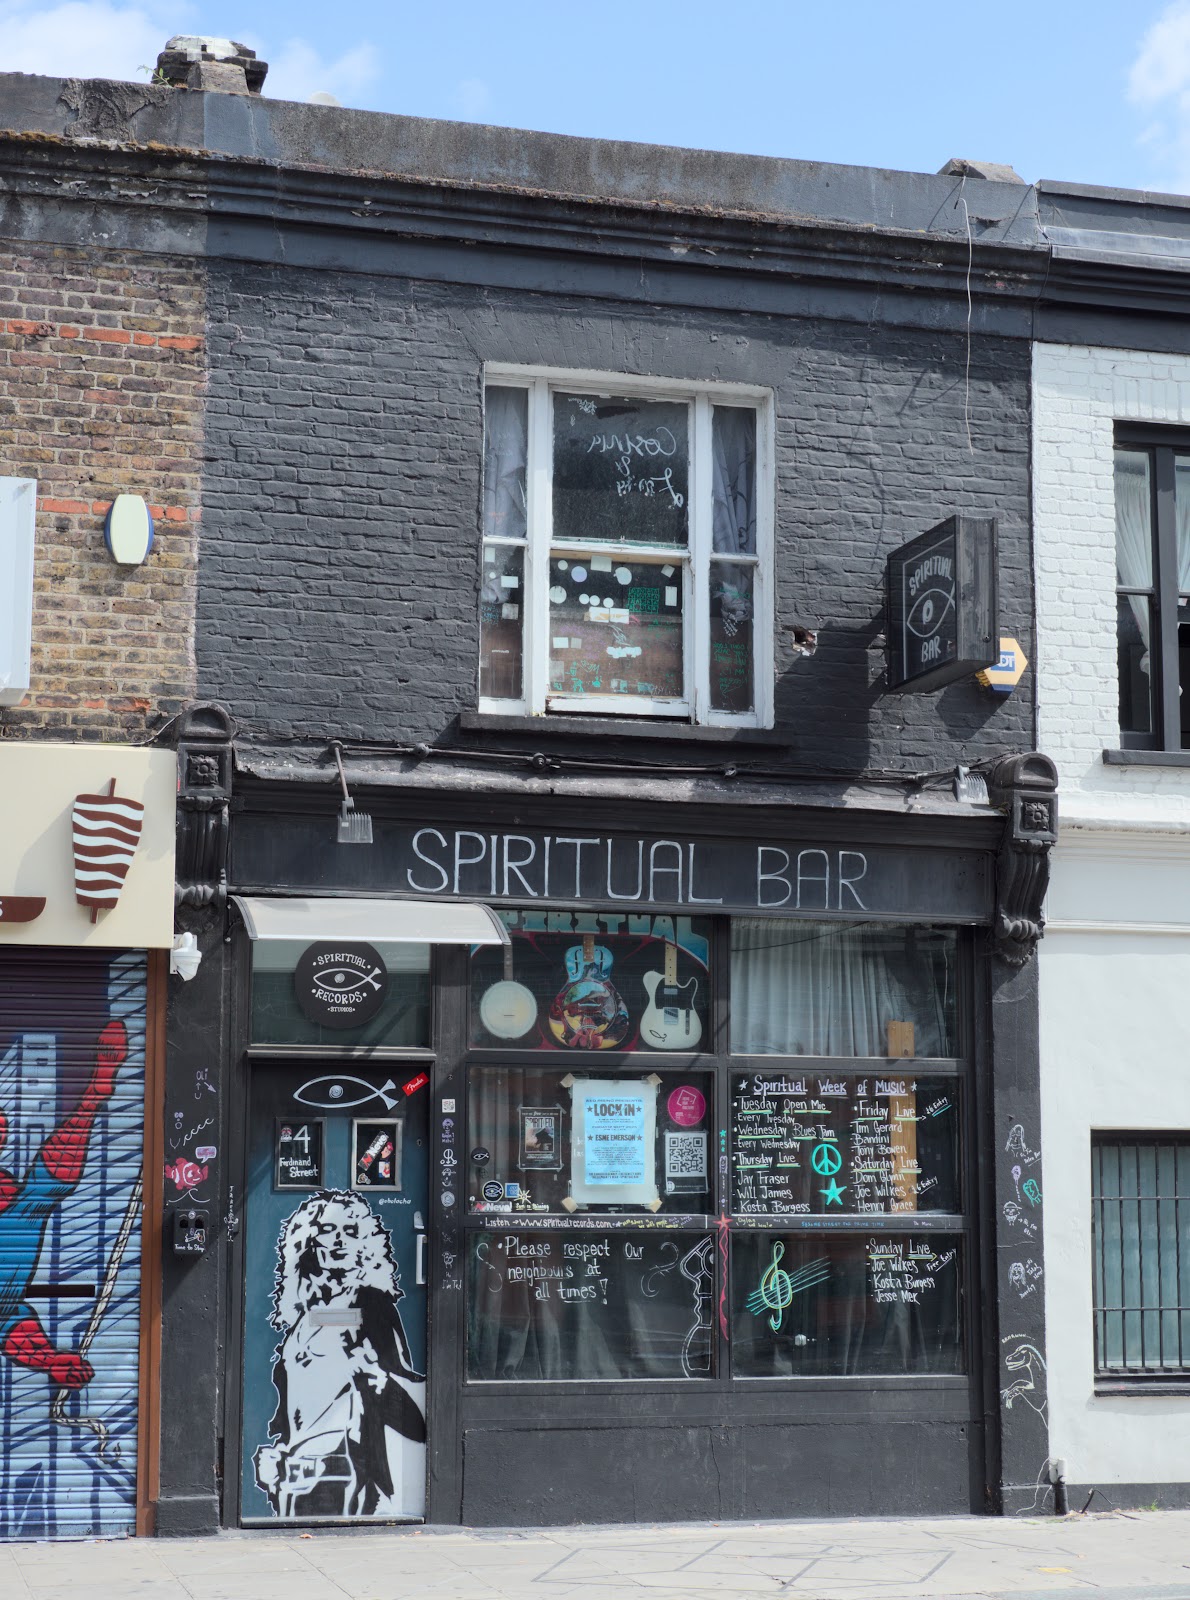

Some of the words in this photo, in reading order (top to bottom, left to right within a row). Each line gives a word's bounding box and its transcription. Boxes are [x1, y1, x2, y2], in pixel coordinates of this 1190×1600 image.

[909, 555, 953, 596] SPIRITUAL
[921, 636, 941, 662] BAR
[996, 656, 1015, 668] DT
[407, 828, 723, 904] SPIRITUAL
[757, 846, 868, 911] BAR
[317, 953, 366, 969] SPIRITUAL
[315, 989, 363, 1004] RECORDS
[753, 1075, 808, 1096] Spiritual
[818, 1079, 847, 1093] Week
[857, 1079, 868, 1093] of
[875, 1080, 906, 1093] MUSIC
[594, 1103, 623, 1117] LOCK
[736, 1096, 777, 1115] Tuesday
[783, 1099, 808, 1115] Open
[810, 1099, 826, 1110] Mic
[859, 1100, 889, 1120] Friday
[896, 1101, 916, 1118] Live
[933, 1096, 949, 1110] Entry
[737, 1112, 761, 1125] Every
[766, 1113, 796, 1126] Tuesday
[738, 1123, 787, 1137] Wednesday
[792, 1123, 817, 1137] Blues
[816, 1124, 836, 1139] Jam
[851, 1121, 870, 1133] Tim
[873, 1120, 903, 1135] Gerard
[293, 1125, 311, 1154] 4
[738, 1140, 757, 1151] Every
[760, 1140, 801, 1152] Wednesday
[852, 1133, 890, 1145] Bandini
[734, 1151, 773, 1167] Thursday
[778, 1152, 796, 1163] Live
[851, 1145, 874, 1158] Tony
[280, 1156, 312, 1167] Ferdinand
[854, 1156, 894, 1173] Saturday
[901, 1156, 919, 1168] Live
[289, 1164, 319, 1178] Street
[756, 1170, 790, 1184] Fraser
[851, 1171, 877, 1184] Dom
[920, 1176, 939, 1189] Entry
[759, 1185, 793, 1199] James
[853, 1185, 871, 1199] Joe
[875, 1182, 907, 1198] Wilkes
[739, 1200, 768, 1213] Kosta
[770, 1200, 811, 1213] Burgess
[857, 1200, 885, 1214] Henry
[890, 1198, 915, 1211] Grace
[485, 1216, 510, 1227] Listen
[504, 1236, 551, 1256] Please
[564, 1239, 610, 1262] respect
[624, 1241, 644, 1258] Our
[869, 1238, 903, 1260] Sunday
[909, 1239, 931, 1254] Live
[871, 1257, 886, 1272] Joe
[926, 1260, 940, 1271] Free
[508, 1260, 574, 1287] neighbours
[587, 1258, 601, 1275] at
[535, 1281, 551, 1299] all
[873, 1272, 902, 1288] Kosta
[904, 1273, 936, 1293] Burgess
[874, 1289, 898, 1303] Jesse
